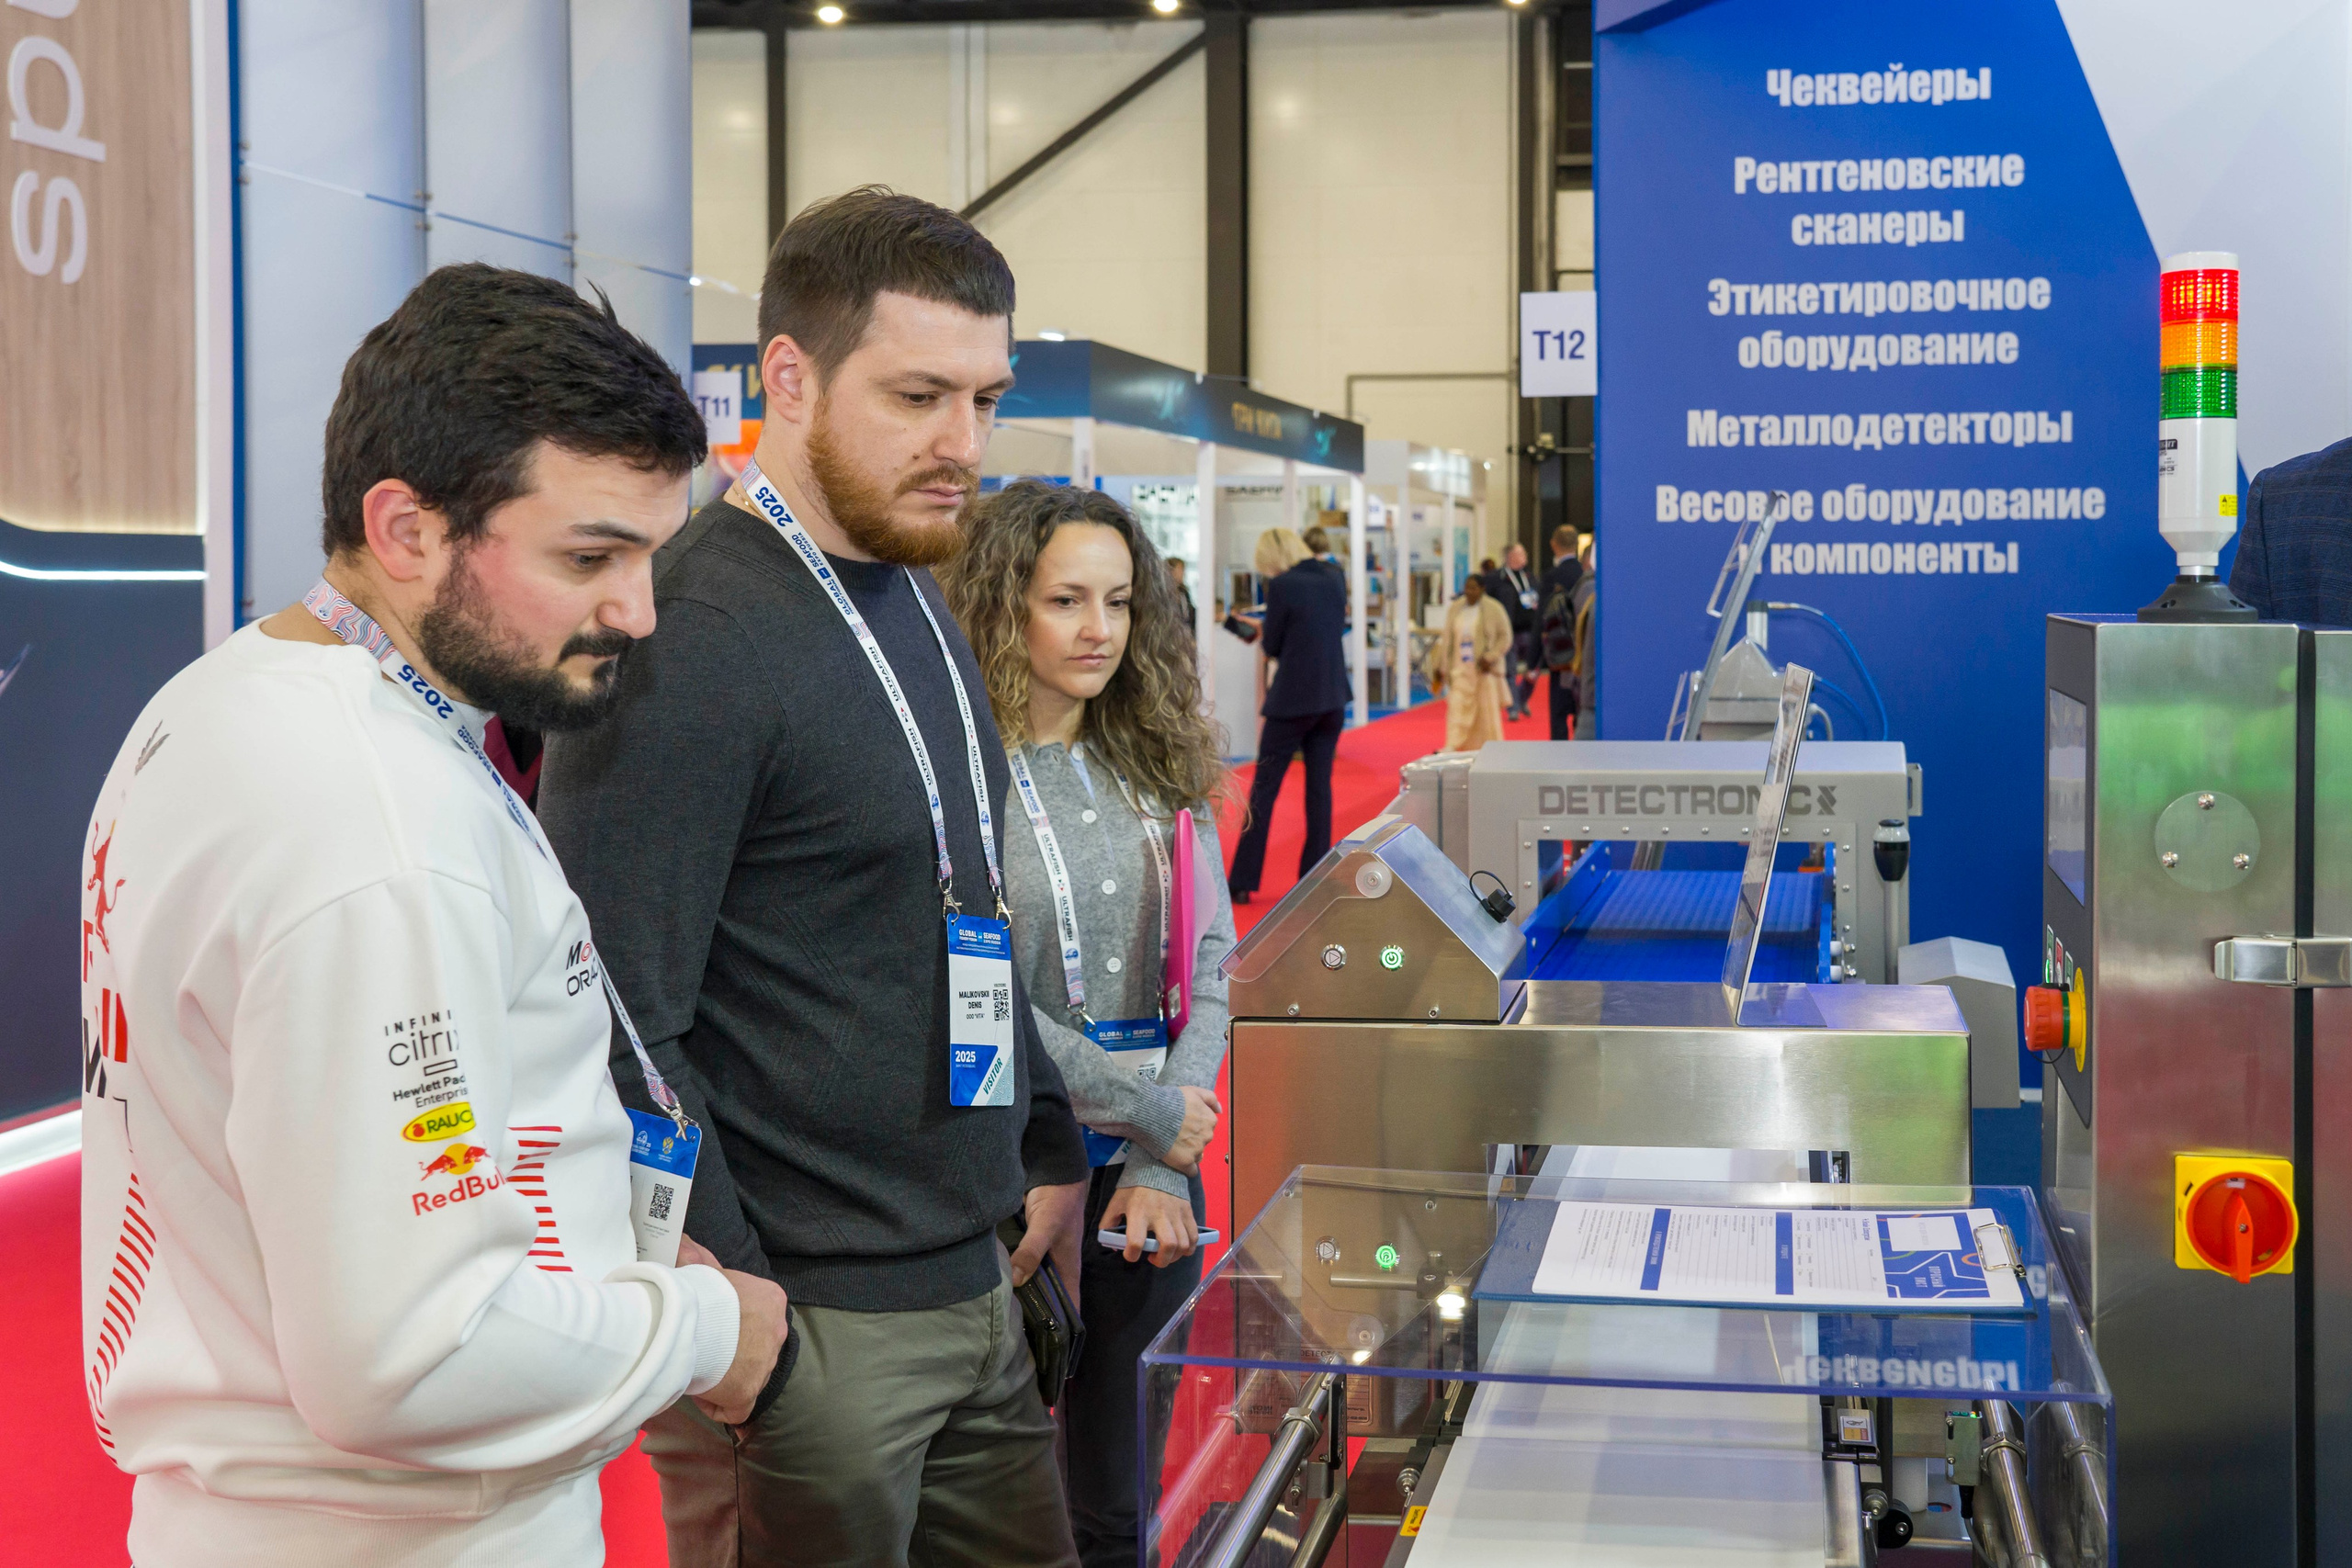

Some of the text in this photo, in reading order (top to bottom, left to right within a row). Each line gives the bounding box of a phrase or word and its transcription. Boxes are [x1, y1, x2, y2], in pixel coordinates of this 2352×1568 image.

[1767, 62, 1991, 107] Чеквейеры
[1734, 152, 2025, 195] Рентгеновские
[1791, 209, 1964, 247] сканеры
[1707, 276, 2051, 317] Этикетировочное
[1532, 330, 1586, 361] T12
[1738, 329, 2019, 372] оборудование
[1687, 409, 2073, 451] Металлодетекторы
[754, 486, 794, 527] 2025
[1656, 483, 2106, 526] Весовое оборудование
[791, 534, 851, 615] GLOBAL SEAFOOD
[1770, 542, 2018, 575] компоненты
[397, 663, 455, 719] 2025
[868, 646, 899, 702] ULTRAFISH
[908, 727, 933, 786] ULTRAFISH
[972, 745, 985, 803] ULTRAFISH
[1538, 784, 1812, 816] DETECTRONC
[1044, 833, 1061, 875] ULTRAFISH
[958, 929, 1001, 941] GLOBAL SEAFOOD
[1061, 896, 1074, 942] ULTRAFISH
[955, 1050, 976, 1063] 2025
[982, 1056, 1003, 1095] VISITOR
[393, 1079, 441, 1101] Hewlett
